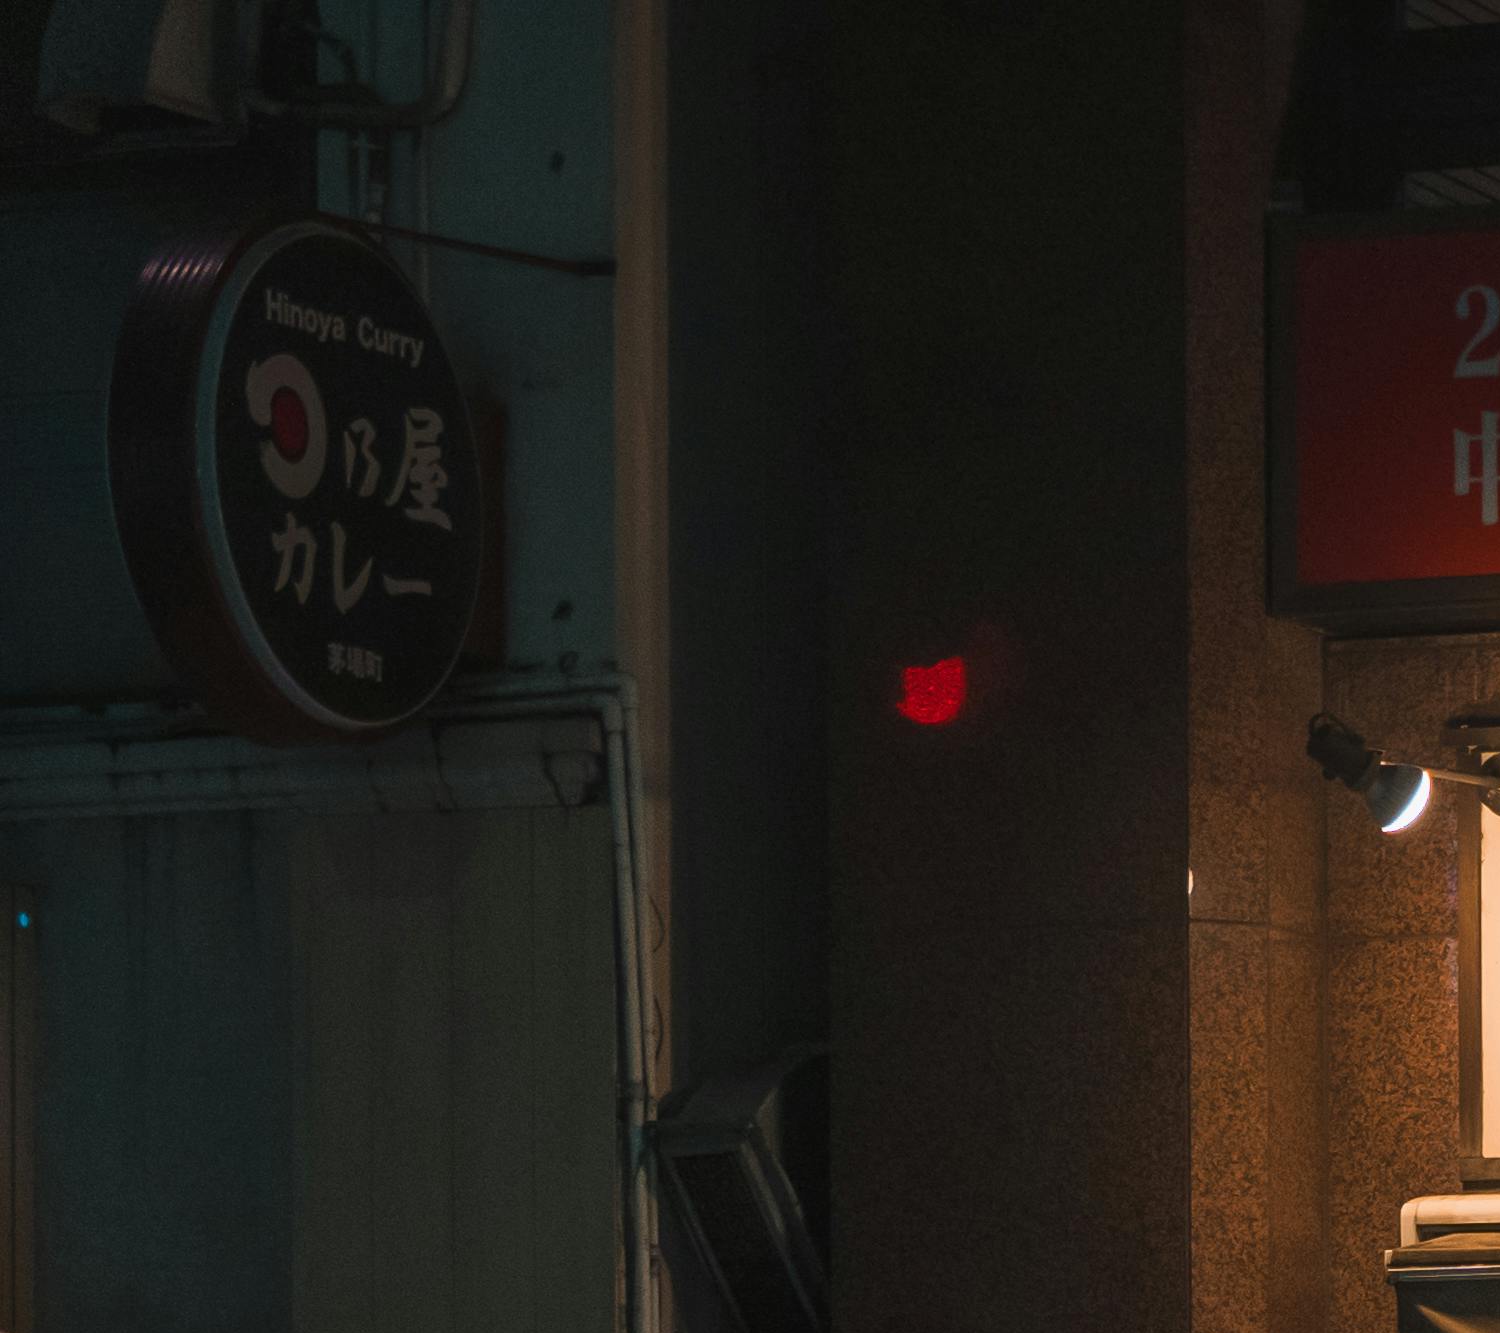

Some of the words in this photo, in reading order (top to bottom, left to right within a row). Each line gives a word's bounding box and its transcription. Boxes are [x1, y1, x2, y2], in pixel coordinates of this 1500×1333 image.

[266, 288, 345, 342] Hinoya
[357, 317, 425, 368] Curry
[272, 511, 433, 615] カレー
